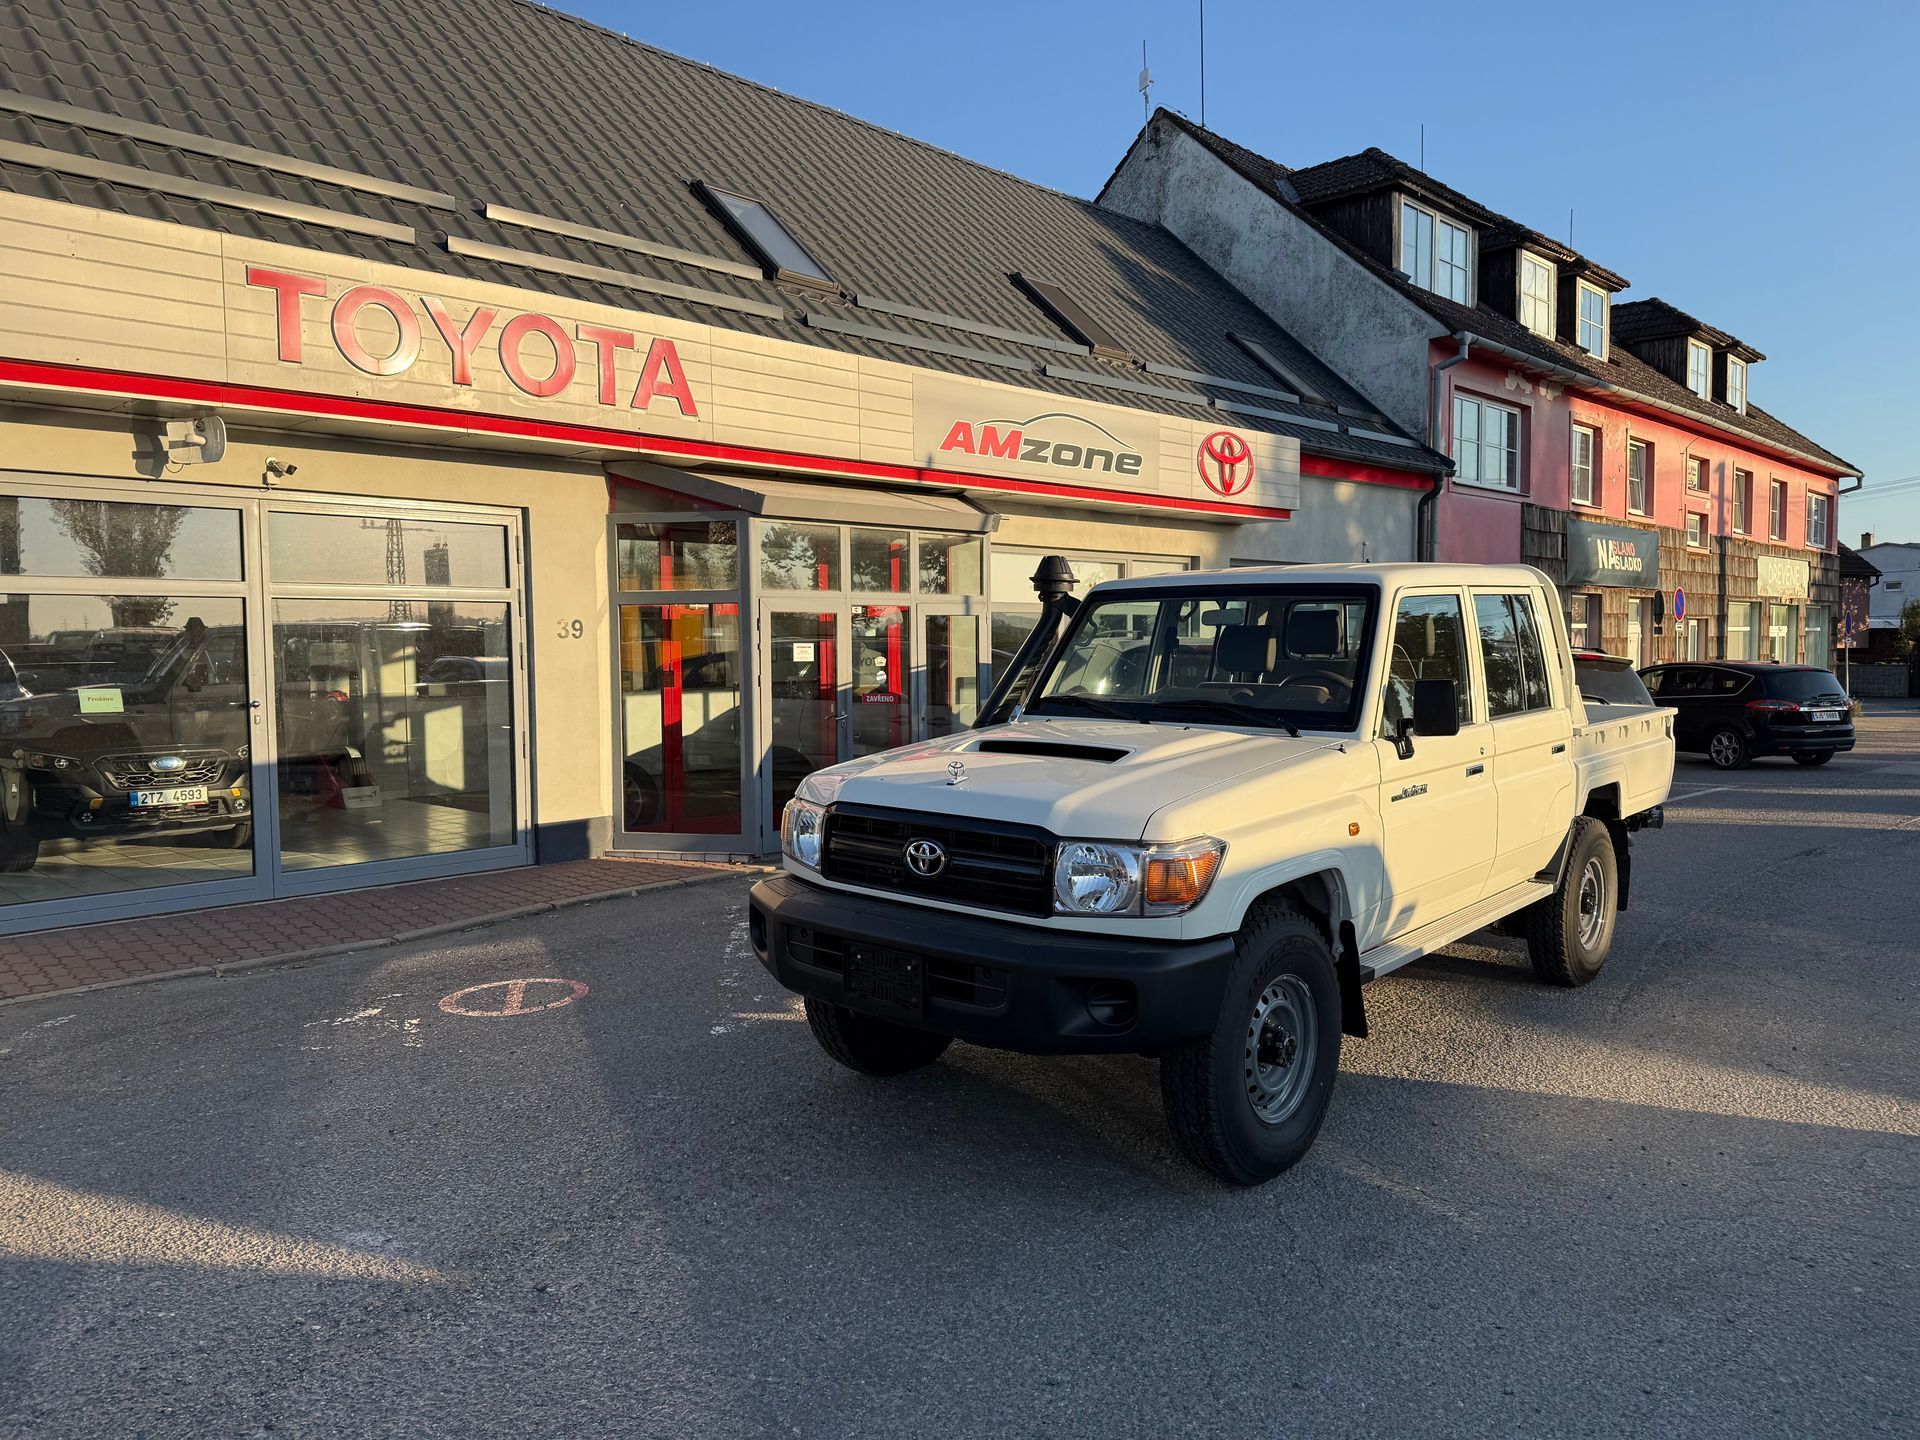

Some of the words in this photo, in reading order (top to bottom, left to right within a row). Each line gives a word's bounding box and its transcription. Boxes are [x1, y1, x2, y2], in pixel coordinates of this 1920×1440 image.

[246, 265, 699, 417] TOYOTA
[938, 420, 1143, 476] AMzone
[1597, 539, 1615, 570] NA
[1614, 555, 1643, 572] SLADKO
[557, 618, 584, 639] 39
[140, 791, 164, 804] 2TZ
[173, 789, 202, 801] 4593
